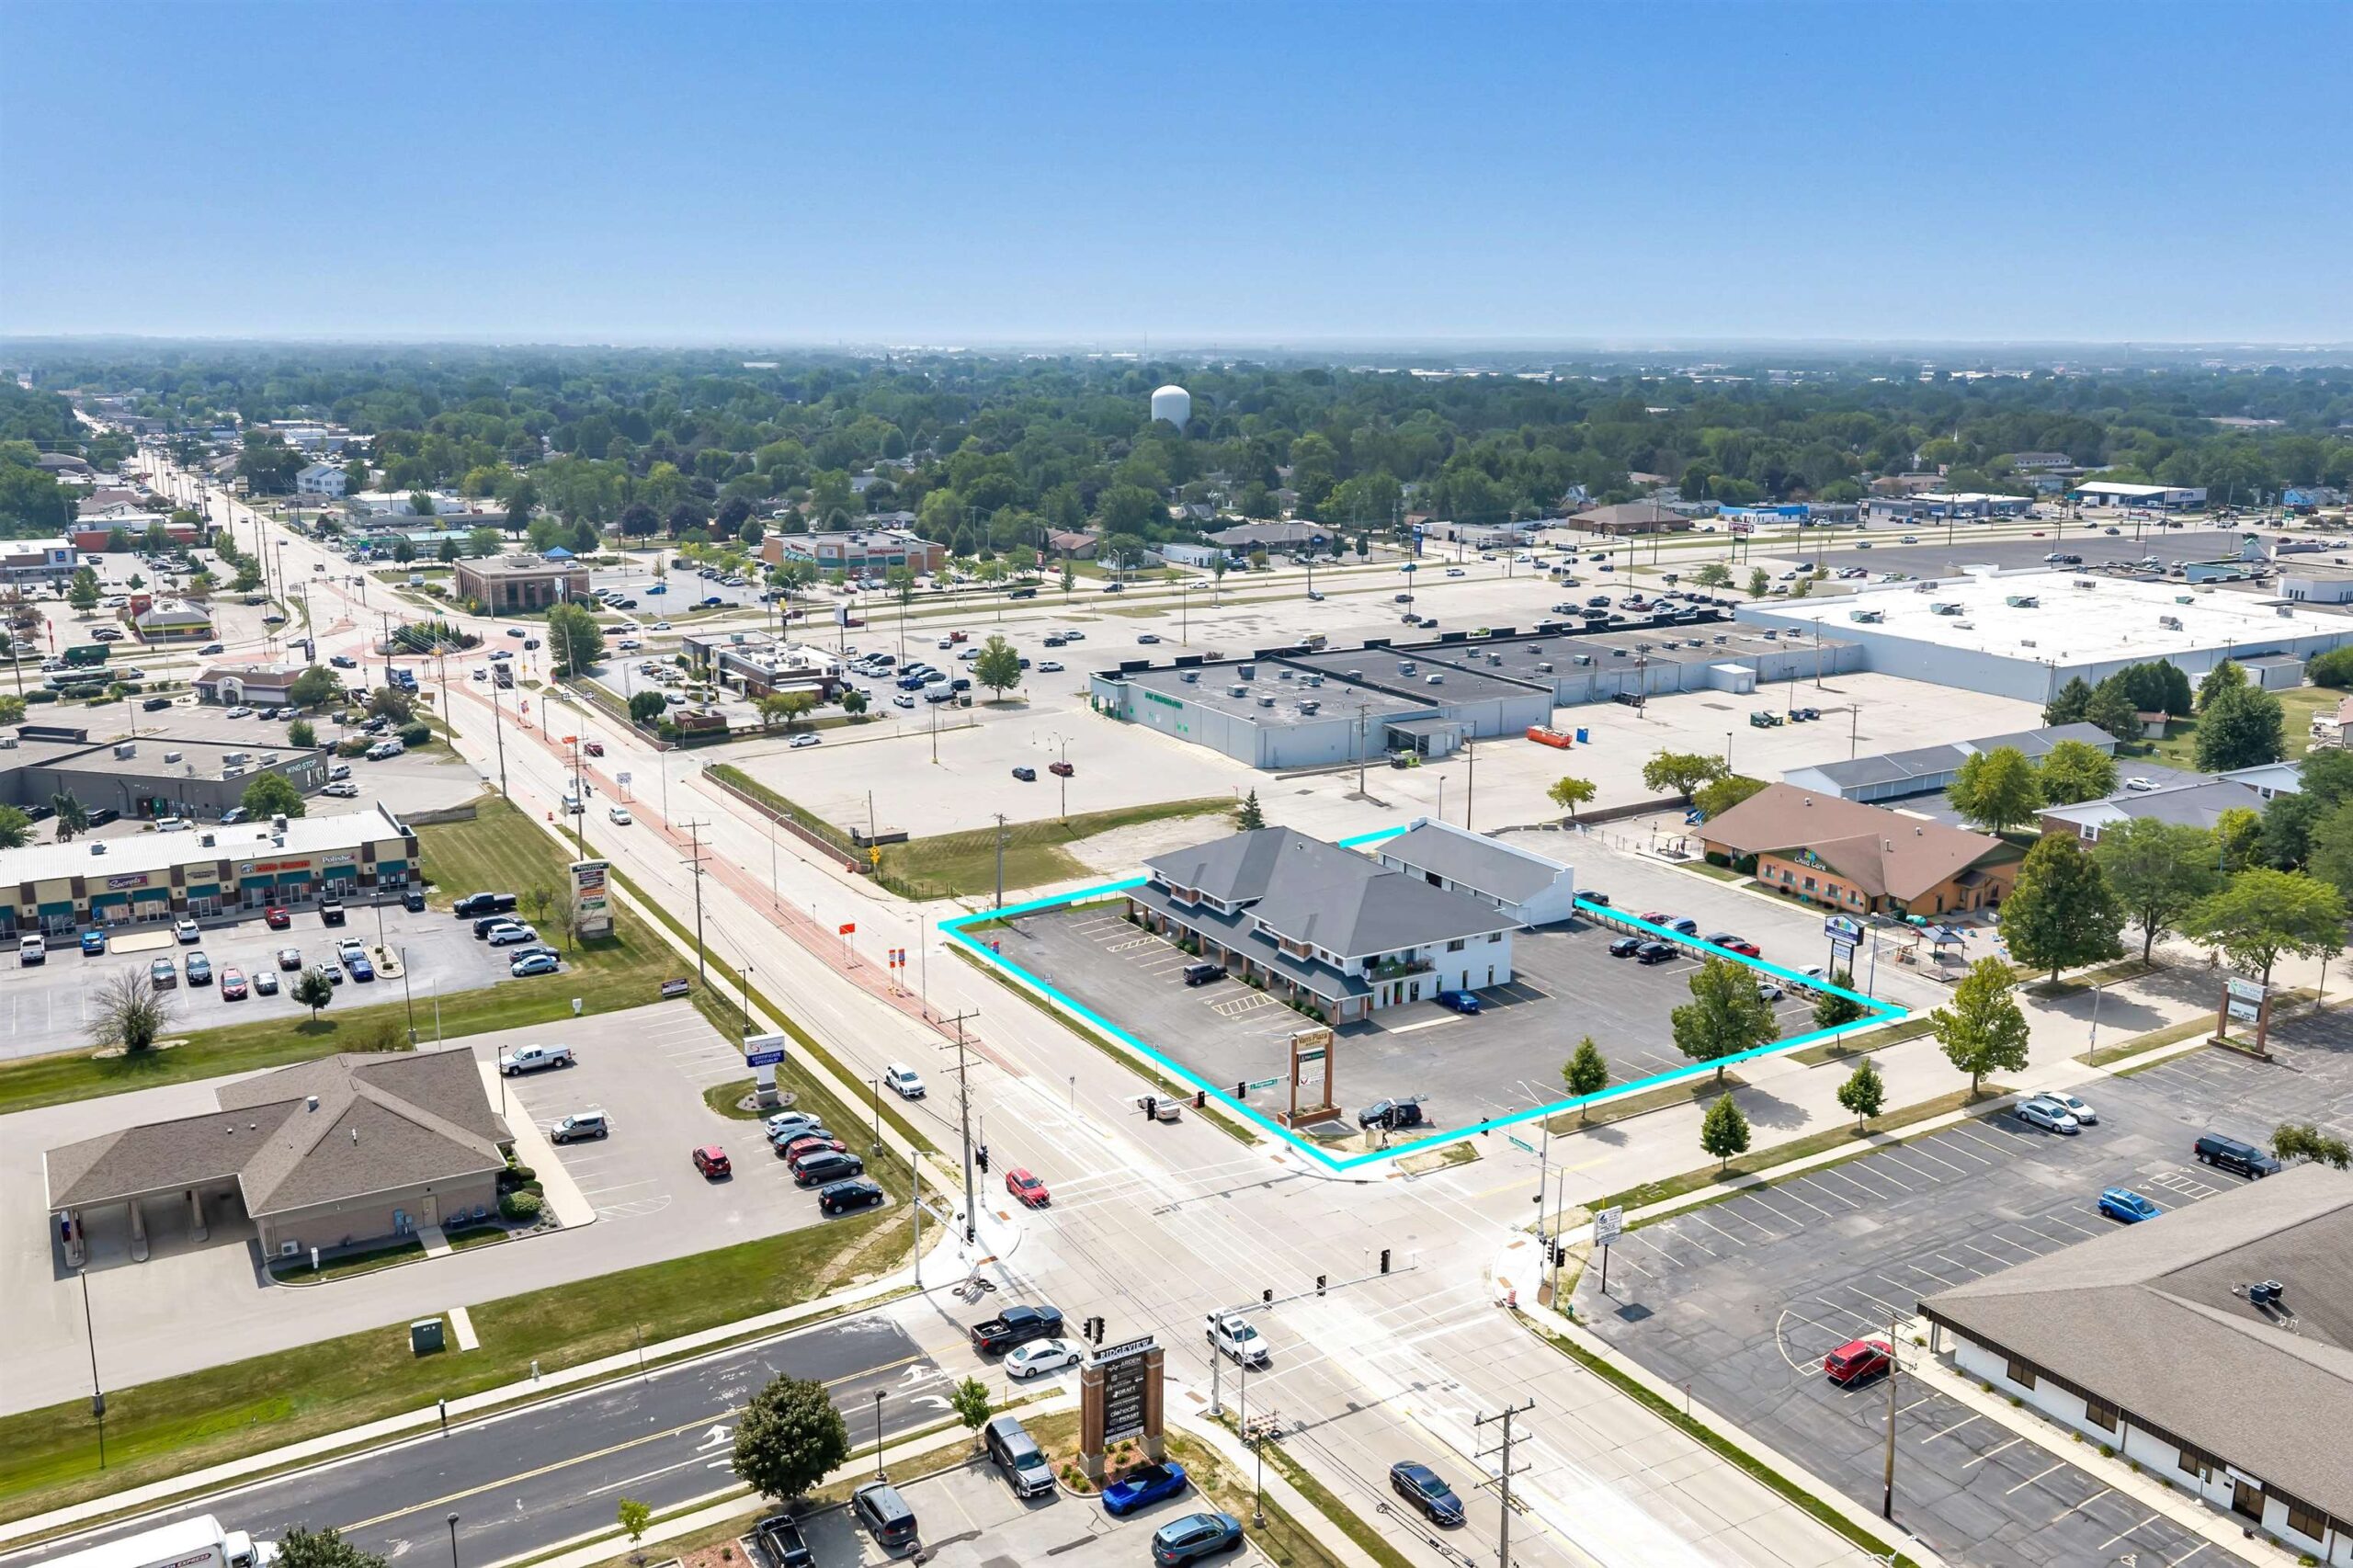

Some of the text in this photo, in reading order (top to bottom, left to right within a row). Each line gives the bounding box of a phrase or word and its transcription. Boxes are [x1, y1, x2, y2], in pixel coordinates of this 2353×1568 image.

[1794, 857, 1827, 871] Child Care
[752, 1051, 781, 1062] CERTIFICATE
[1099, 1338, 1151, 1359] RIDGEVIEW
[1120, 1356, 1142, 1367] ARDEN
